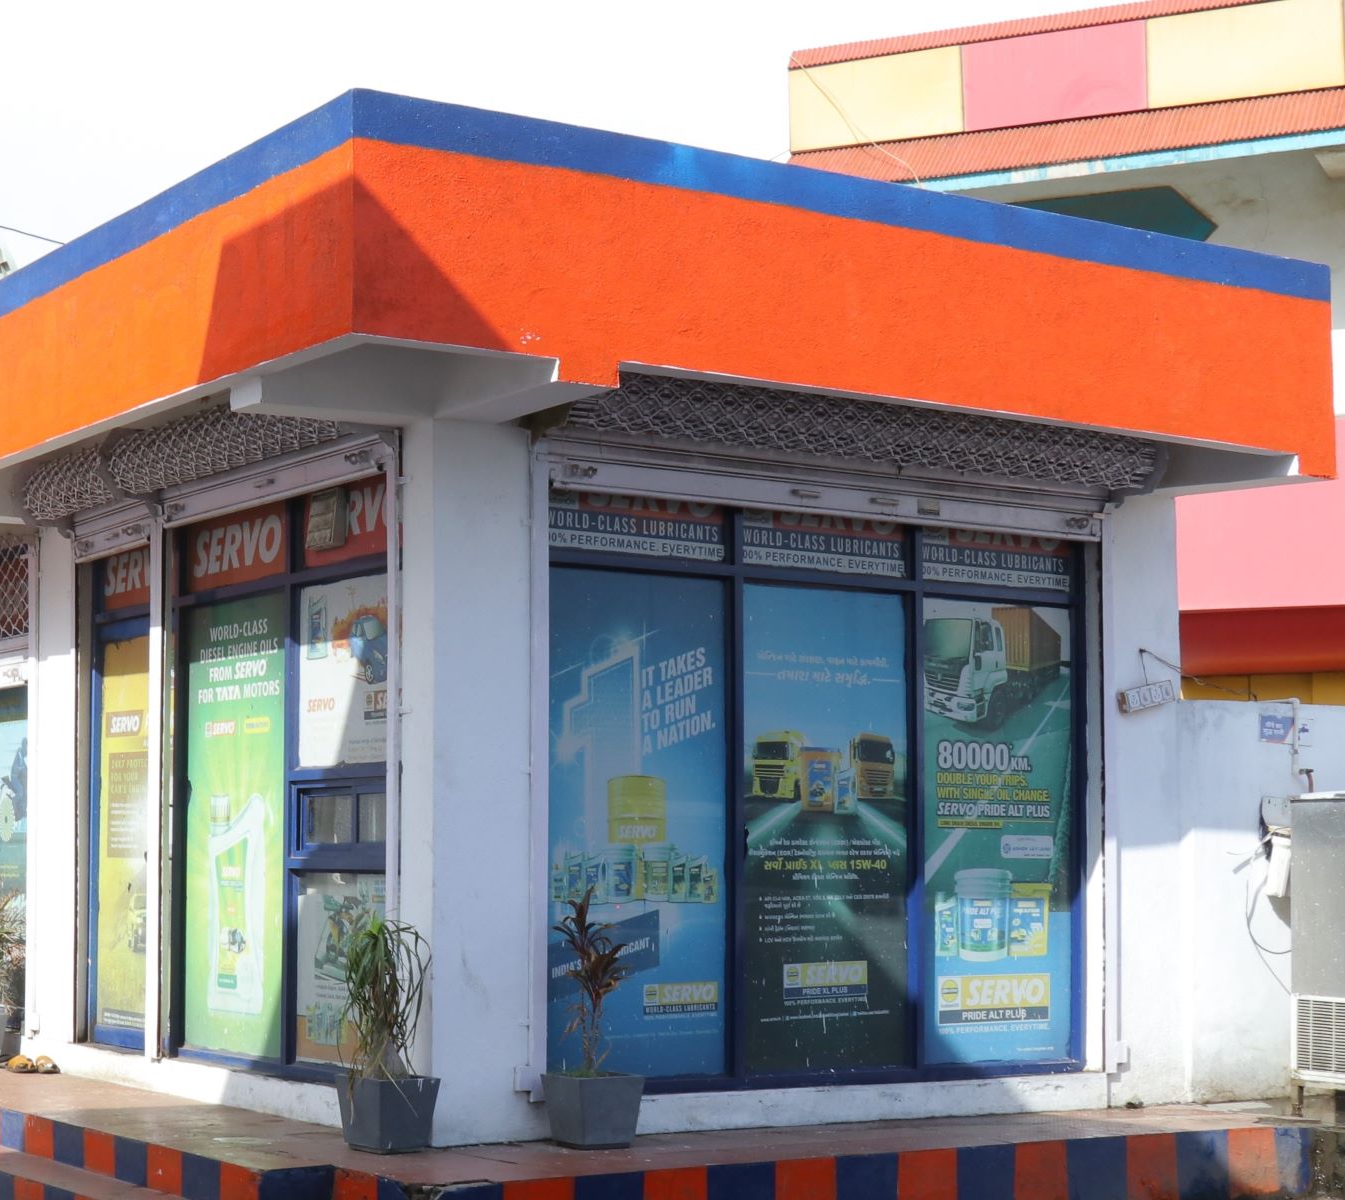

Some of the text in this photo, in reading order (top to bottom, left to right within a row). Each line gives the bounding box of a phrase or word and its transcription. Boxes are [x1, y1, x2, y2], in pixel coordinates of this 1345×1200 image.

[548, 510, 718, 542] WORLD-CLASS LUBRICANTS
[193, 514, 282, 578] SERVO
[743, 528, 900, 558] WORLD-CLASS LUBRICANTS
[921, 545, 1064, 573] WORLD-CLASS LUBRICANTS
[209, 618, 268, 642] WORLD-CLASS
[200, 638, 279, 664] DIESEL ENGINE OILS
[209, 658, 268, 683] FROM SERVO
[641, 647, 706, 689] IT TAKES
[198, 679, 280, 704] FOR TATA MOTORS
[642, 666, 714, 711] A LEADER
[307, 696, 335, 713] SERVO
[641, 694, 697, 733] TO RUN
[110, 715, 140, 734] SERVO
[642, 710, 717, 756] A NATION.
[1011, 757, 1031, 771] KM.
[937, 773, 973, 785] DOUBLE
[975, 773, 998, 785] YOUR
[937, 787, 960, 799] WITH
[962, 787, 994, 800] SINGLE
[996, 789, 1011, 800] OIL
[937, 802, 1050, 817] SERVO PRIDE ALT PLUS
[618, 824, 658, 840] SERVO
[849, 859, 887, 870] 15W-40
[551, 958, 582, 979] INDIA'S
[806, 965, 863, 984] SERVO
[663, 984, 715, 1004] SERVO
[802, 986, 848, 995] PRIDE XL PLUS
[966, 978, 1045, 1006] SERVO
[645, 1003, 716, 1014] WORLD-CLASS LUBRICANTS
[962, 1009, 1027, 1020] PRIDE ALT PLUS
